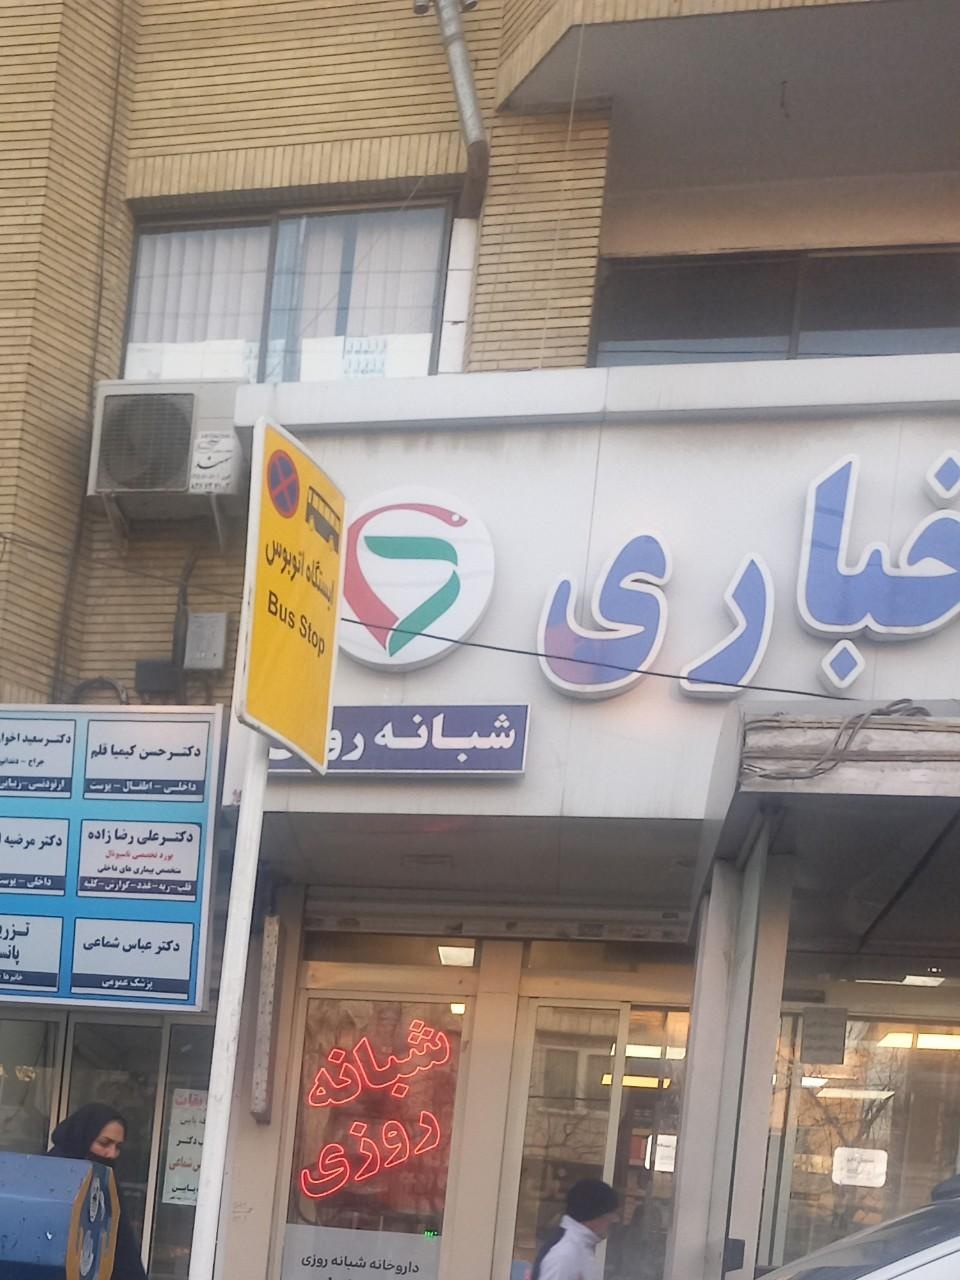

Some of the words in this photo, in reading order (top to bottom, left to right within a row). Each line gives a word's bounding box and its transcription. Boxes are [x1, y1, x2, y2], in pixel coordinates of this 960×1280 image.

[265, 540, 305, 582] اتوبوس
[306, 559, 336, 611] ایستگاه
[268, 590, 296, 629] Bus
[299, 614, 325, 658] Stop
[21, 735, 43, 746] سعید
[43, 733, 72, 746] دکتر
[374, 712, 516, 763] شبانه
[90, 742, 107, 759] قلم
[110, 743, 137, 759] کیمیا
[139, 746, 166, 760] حسن
[166, 744, 201, 761] دکتر
[89, 781, 111, 793] پوست
[122, 780, 153, 792] اطفال
[163, 781, 197, 793] داخلی
[4, 832, 36, 849] مرضیه
[38, 833, 63, 850] دکتر
[87, 828, 112, 844] زاده
[114, 827, 134, 844] رضا
[136, 828, 159, 845] علی
[158, 829, 193, 846] دکتر
[27, 875, 52, 888] داخلی
[122, 937, 152, 953] عباس
[154, 939, 180, 955] دکتر
[101, 977, 129, 989] عمومی
[130, 977, 153, 991] پزشک
[308, 1019, 451, 1107] شبانه
[300, 1110, 441, 1199] روزی
[301, 1253, 328, 1268] روزی
[331, 1255, 367, 1269] شبانه
[369, 1258, 420, 1275] داروخانه
